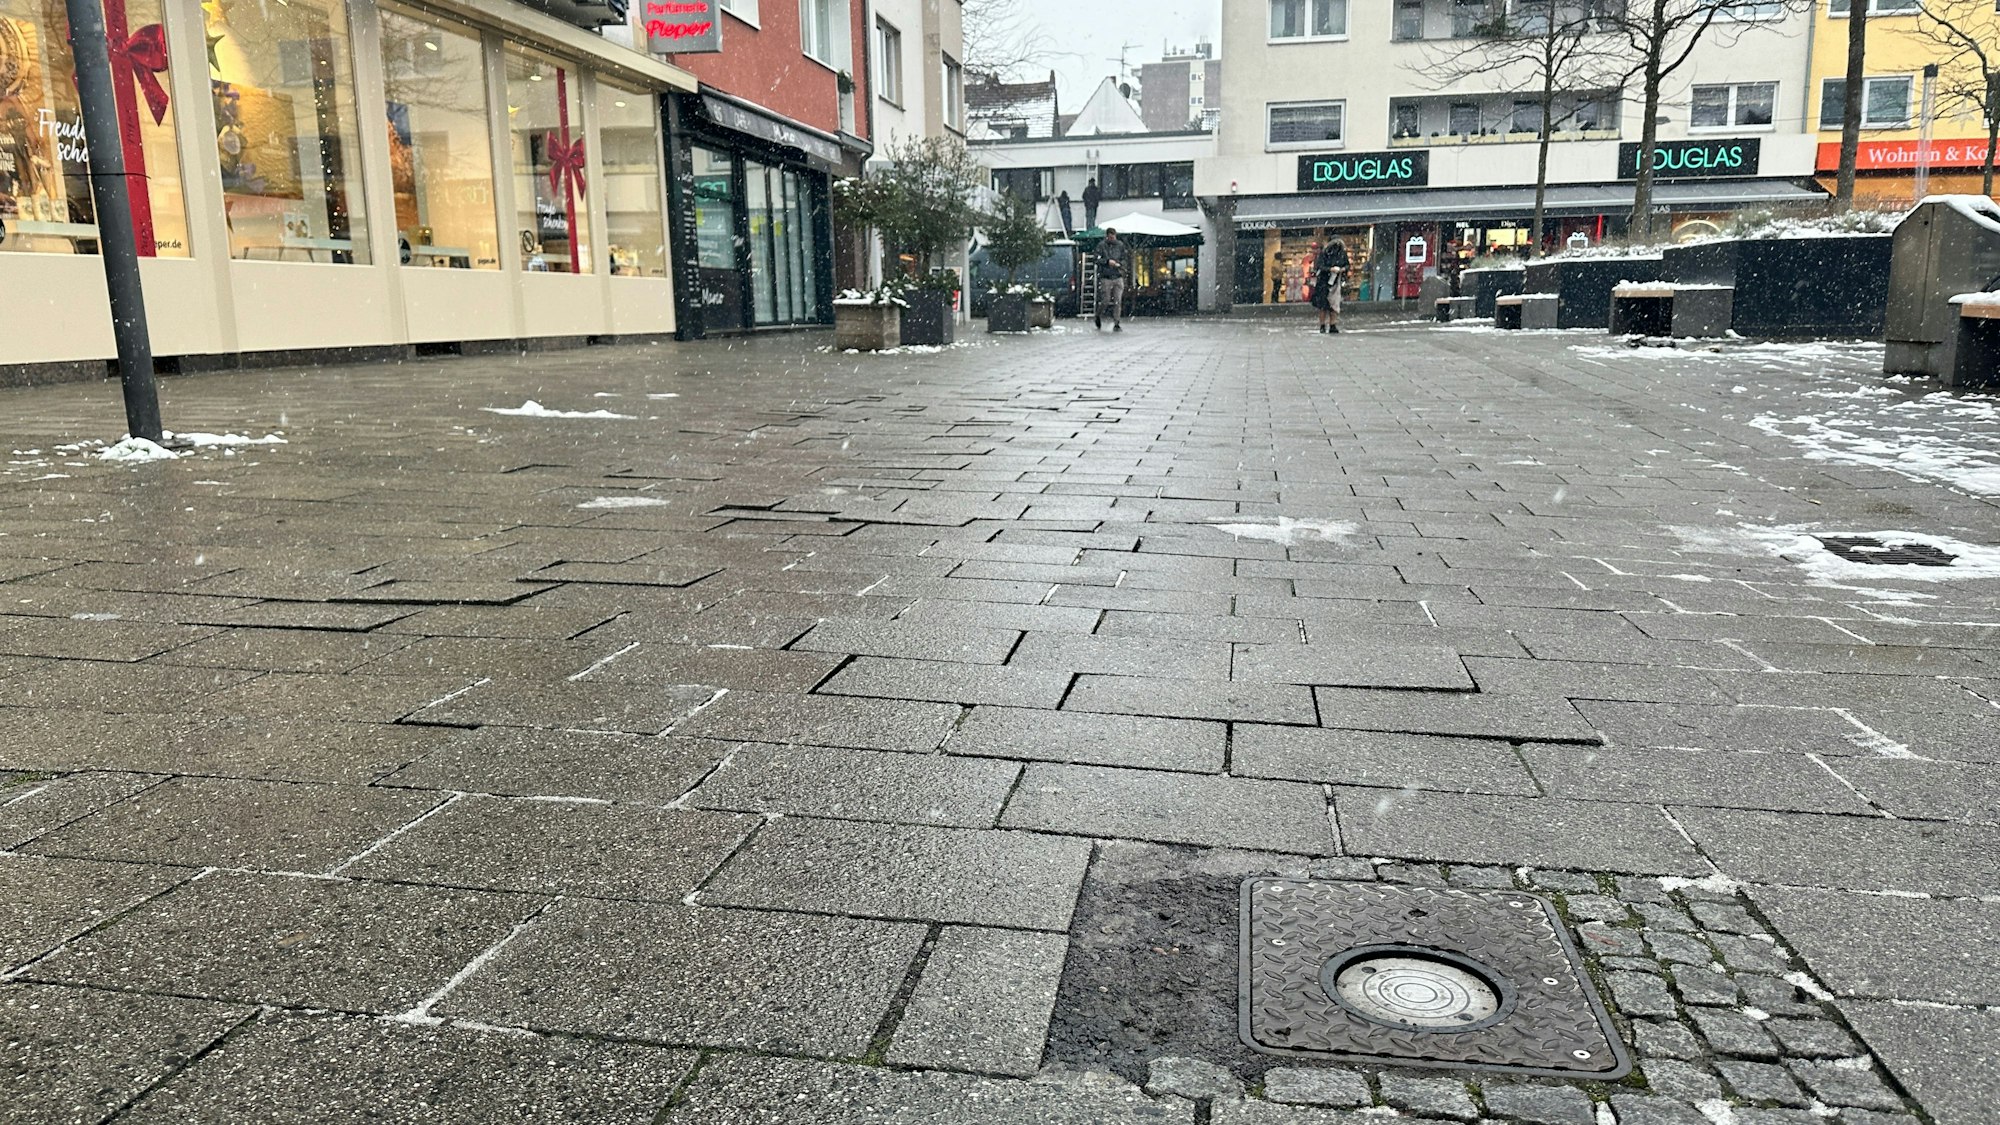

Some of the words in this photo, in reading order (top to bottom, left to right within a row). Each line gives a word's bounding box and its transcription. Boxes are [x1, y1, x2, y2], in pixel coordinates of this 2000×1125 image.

[645, 20, 712, 41] Pieper
[1635, 146, 1742, 171] OUGLAS
[1868, 147, 1940, 163] Wohnn
[1945, 146, 1960, 161] &
[1314, 158, 1412, 182] DOUGLAS
